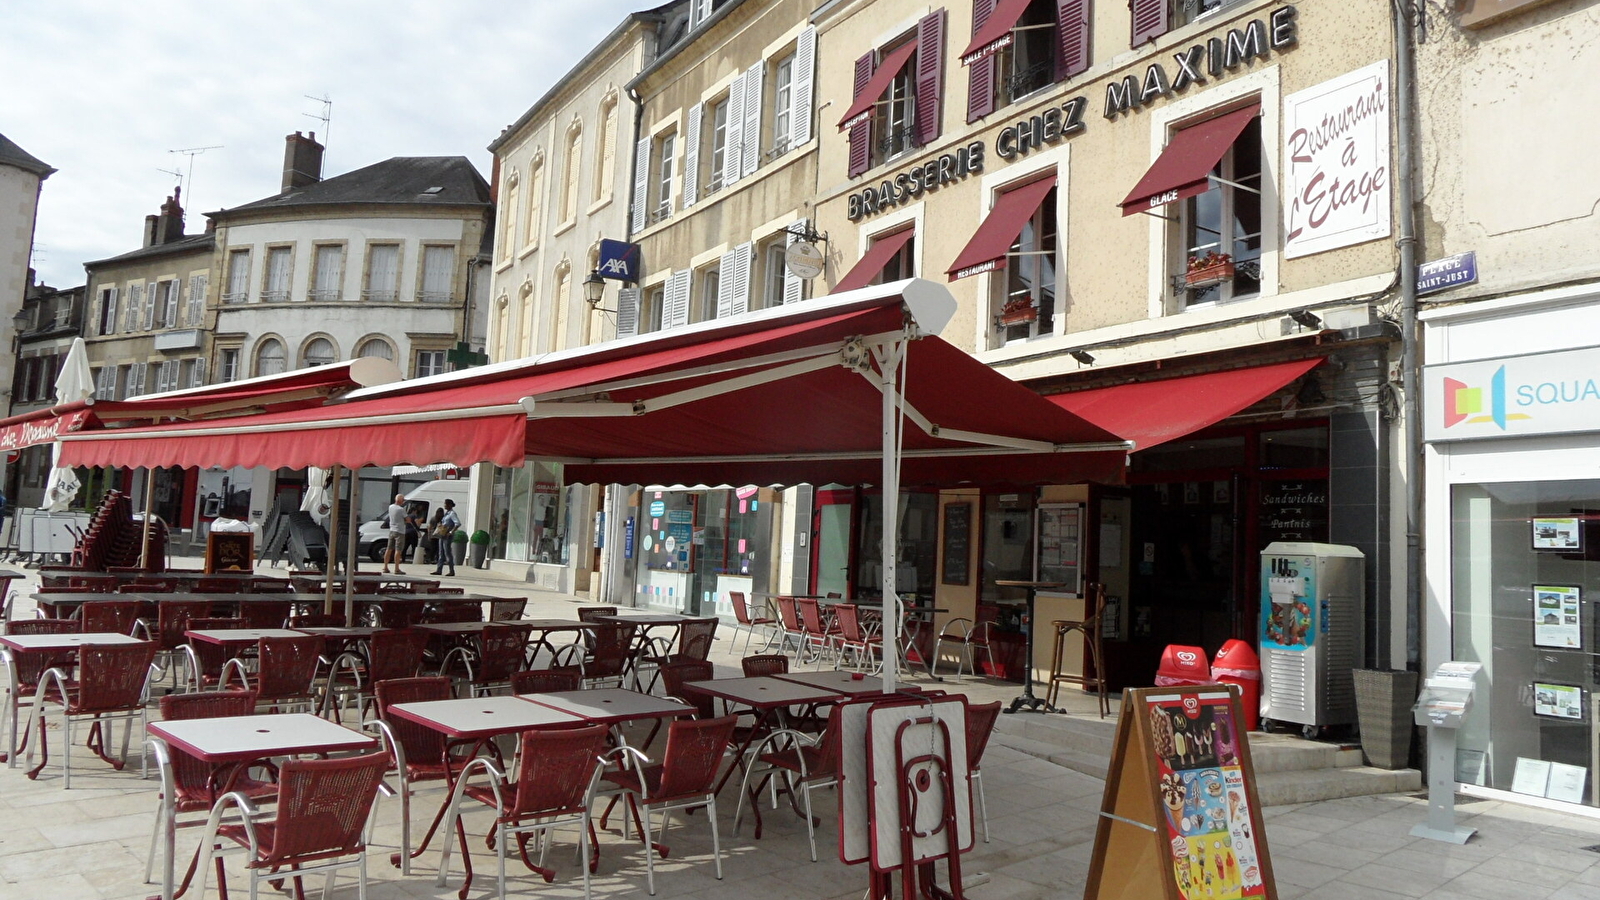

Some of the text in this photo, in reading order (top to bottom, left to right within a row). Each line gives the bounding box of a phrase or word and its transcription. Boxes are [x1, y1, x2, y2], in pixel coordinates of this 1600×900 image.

[963, 49, 982, 66] SALLE
[847, 5, 1298, 221] BRASSERIE CHEZ MAXIME
[1288, 77, 1386, 176] Restaurant
[1341, 136, 1358, 168] à
[1150, 190, 1179, 208] GLACE
[600, 258, 628, 275] AXA
[957, 260, 996, 279] RESTAURANT
[1421, 259, 1462, 277] PLACE
[1417, 270, 1469, 290] SAINT-JUST
[1263, 492, 1325, 505] Sandwiches
